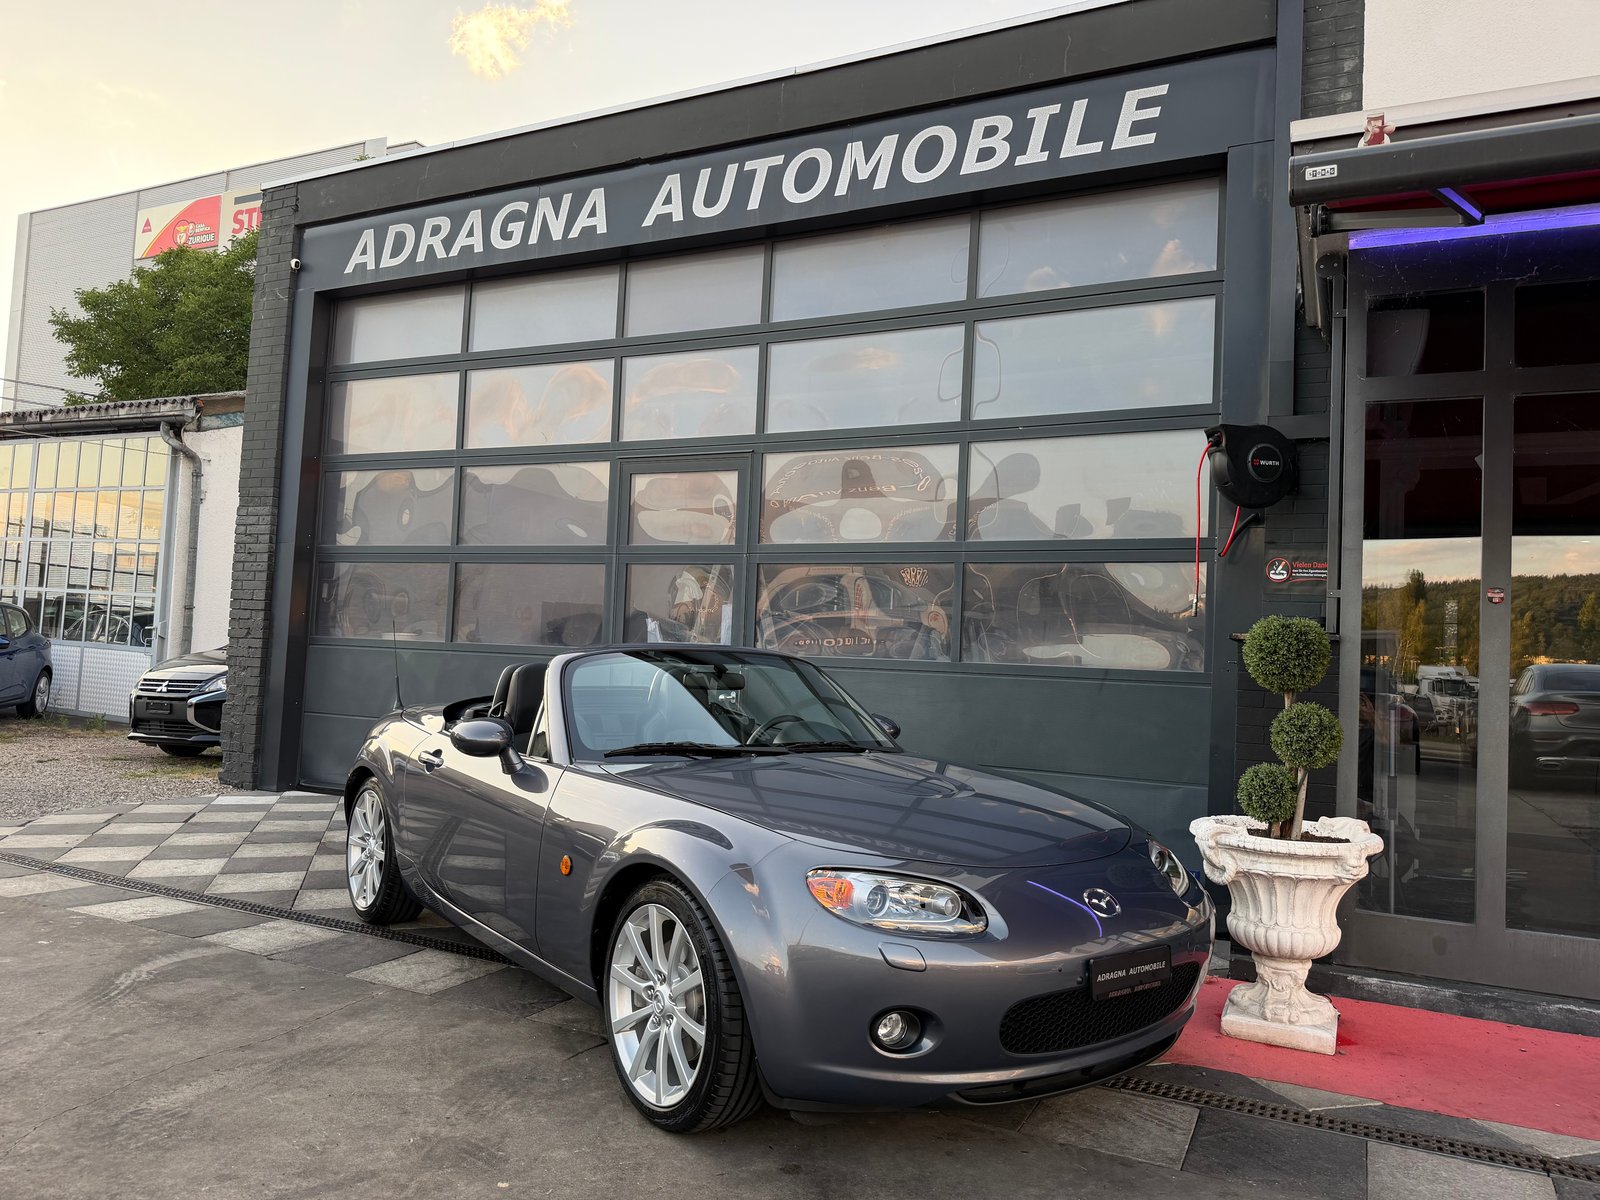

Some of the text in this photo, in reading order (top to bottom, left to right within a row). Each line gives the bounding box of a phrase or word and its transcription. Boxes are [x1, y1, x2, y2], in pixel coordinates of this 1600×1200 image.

[343, 84, 1170, 274] ADRAGNA AUTOMOBILE
[188, 232, 215, 245] ZURIQUE
[1096, 961, 1166, 982] ADRAGNA AUTOMOBILE
